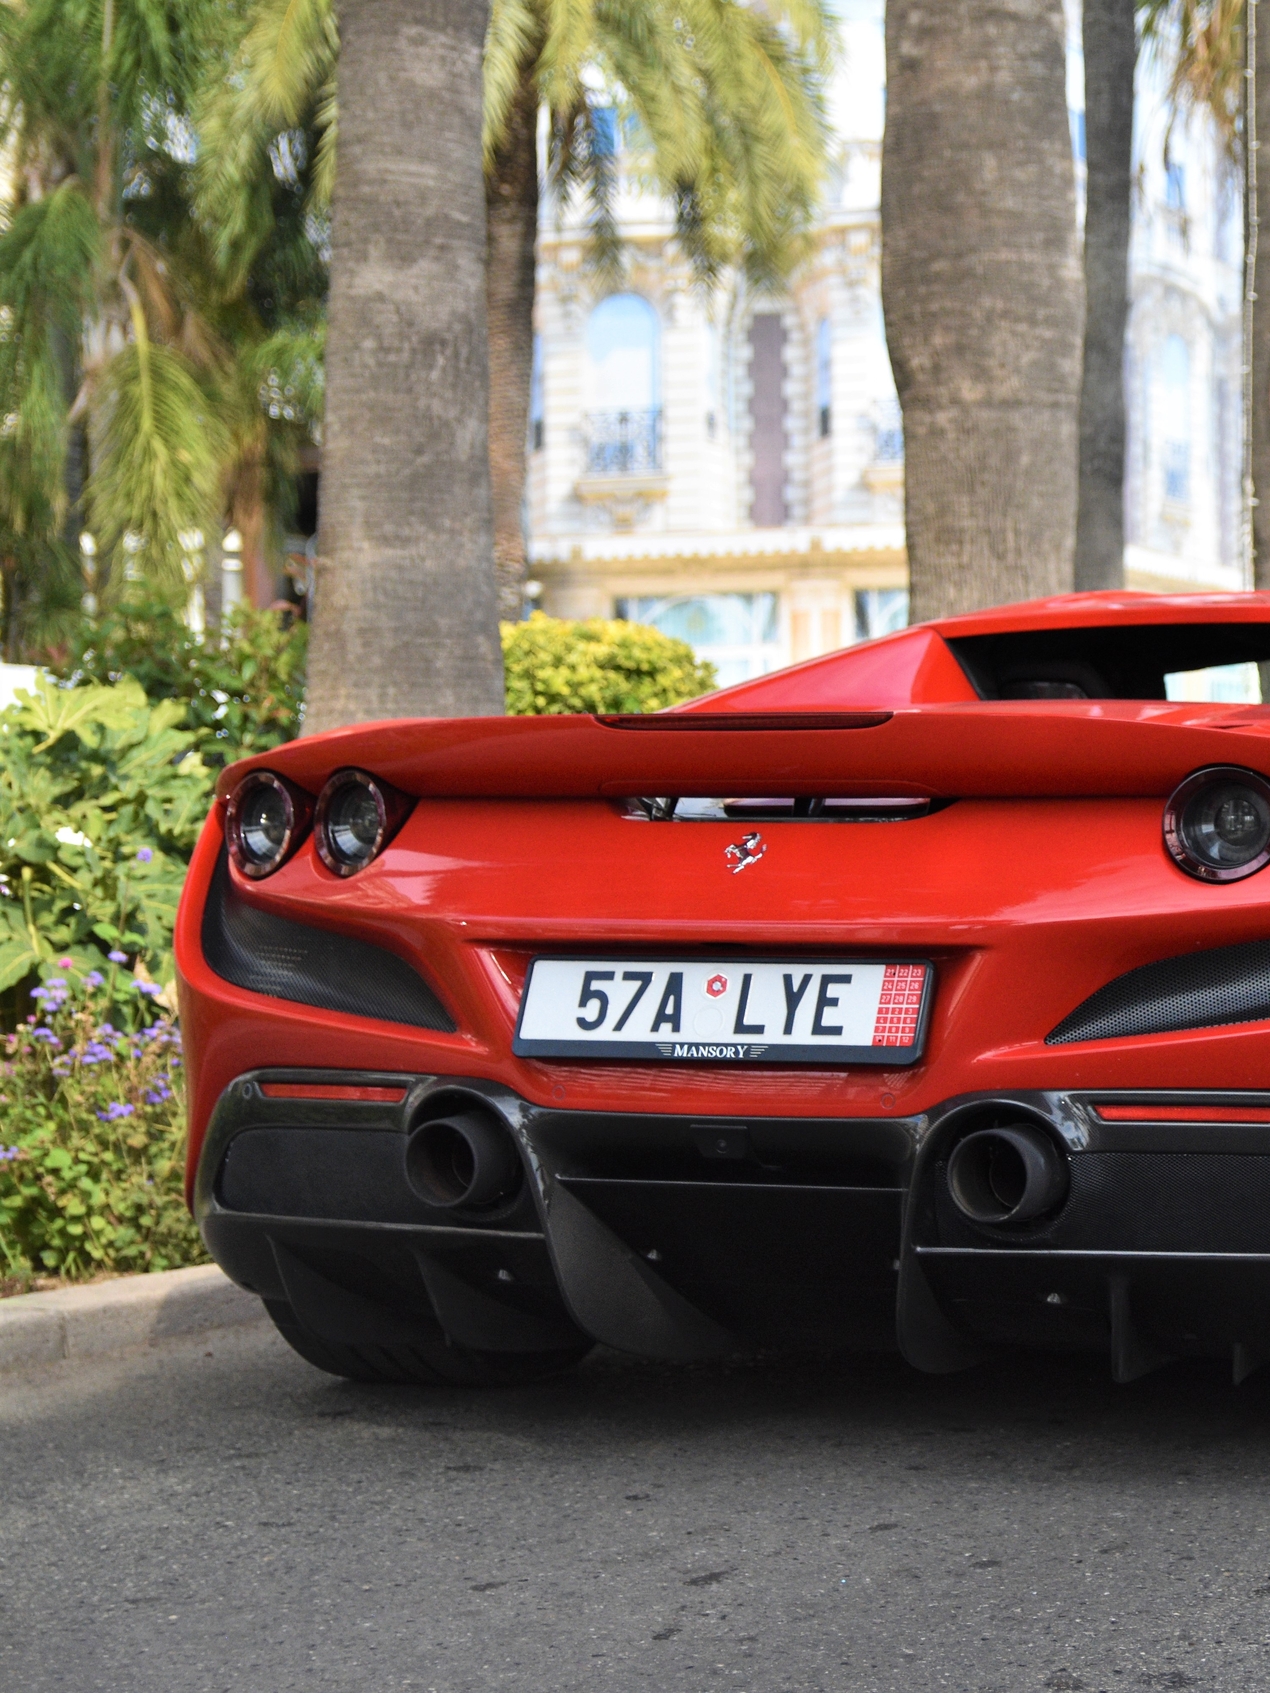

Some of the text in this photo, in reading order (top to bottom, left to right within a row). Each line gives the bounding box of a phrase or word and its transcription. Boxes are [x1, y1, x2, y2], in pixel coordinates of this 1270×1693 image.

[576, 971, 853, 1036] 57A LYE
[673, 1044, 748, 1058] MANSORY
